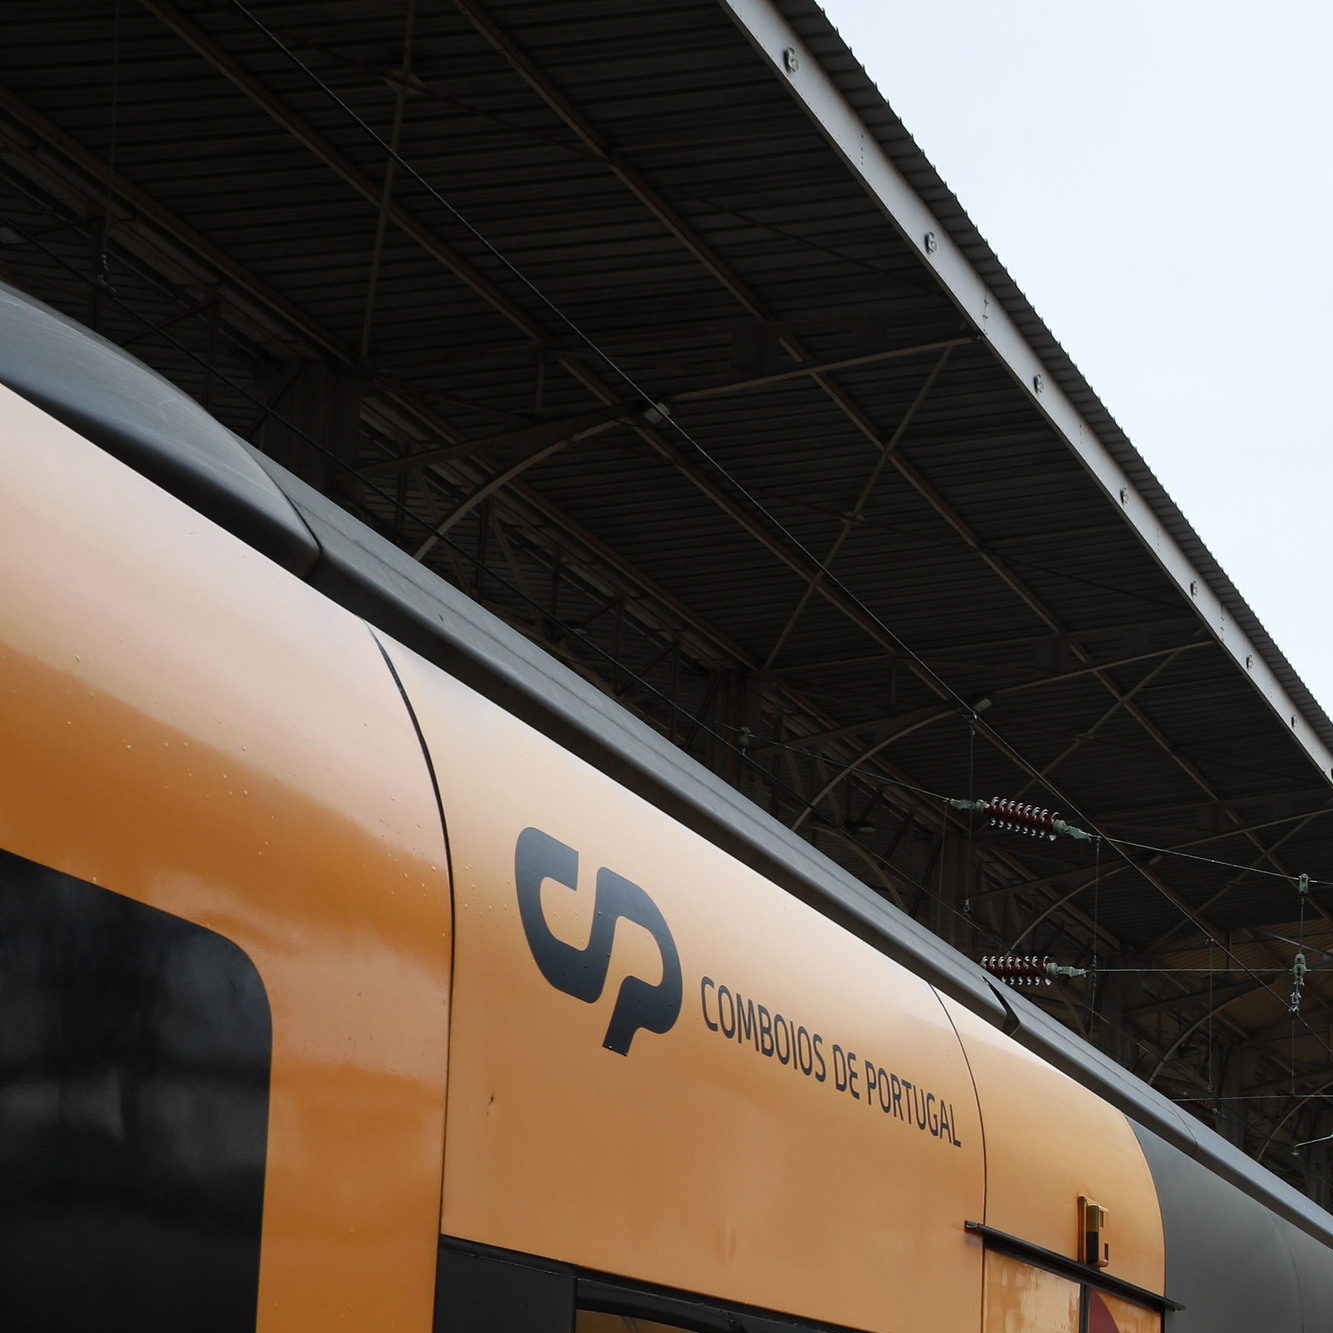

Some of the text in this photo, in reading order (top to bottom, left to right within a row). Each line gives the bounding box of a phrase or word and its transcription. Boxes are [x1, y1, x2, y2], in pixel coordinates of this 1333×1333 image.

[700, 975, 962, 1148] COMBOIOS DE PORTUGAL
